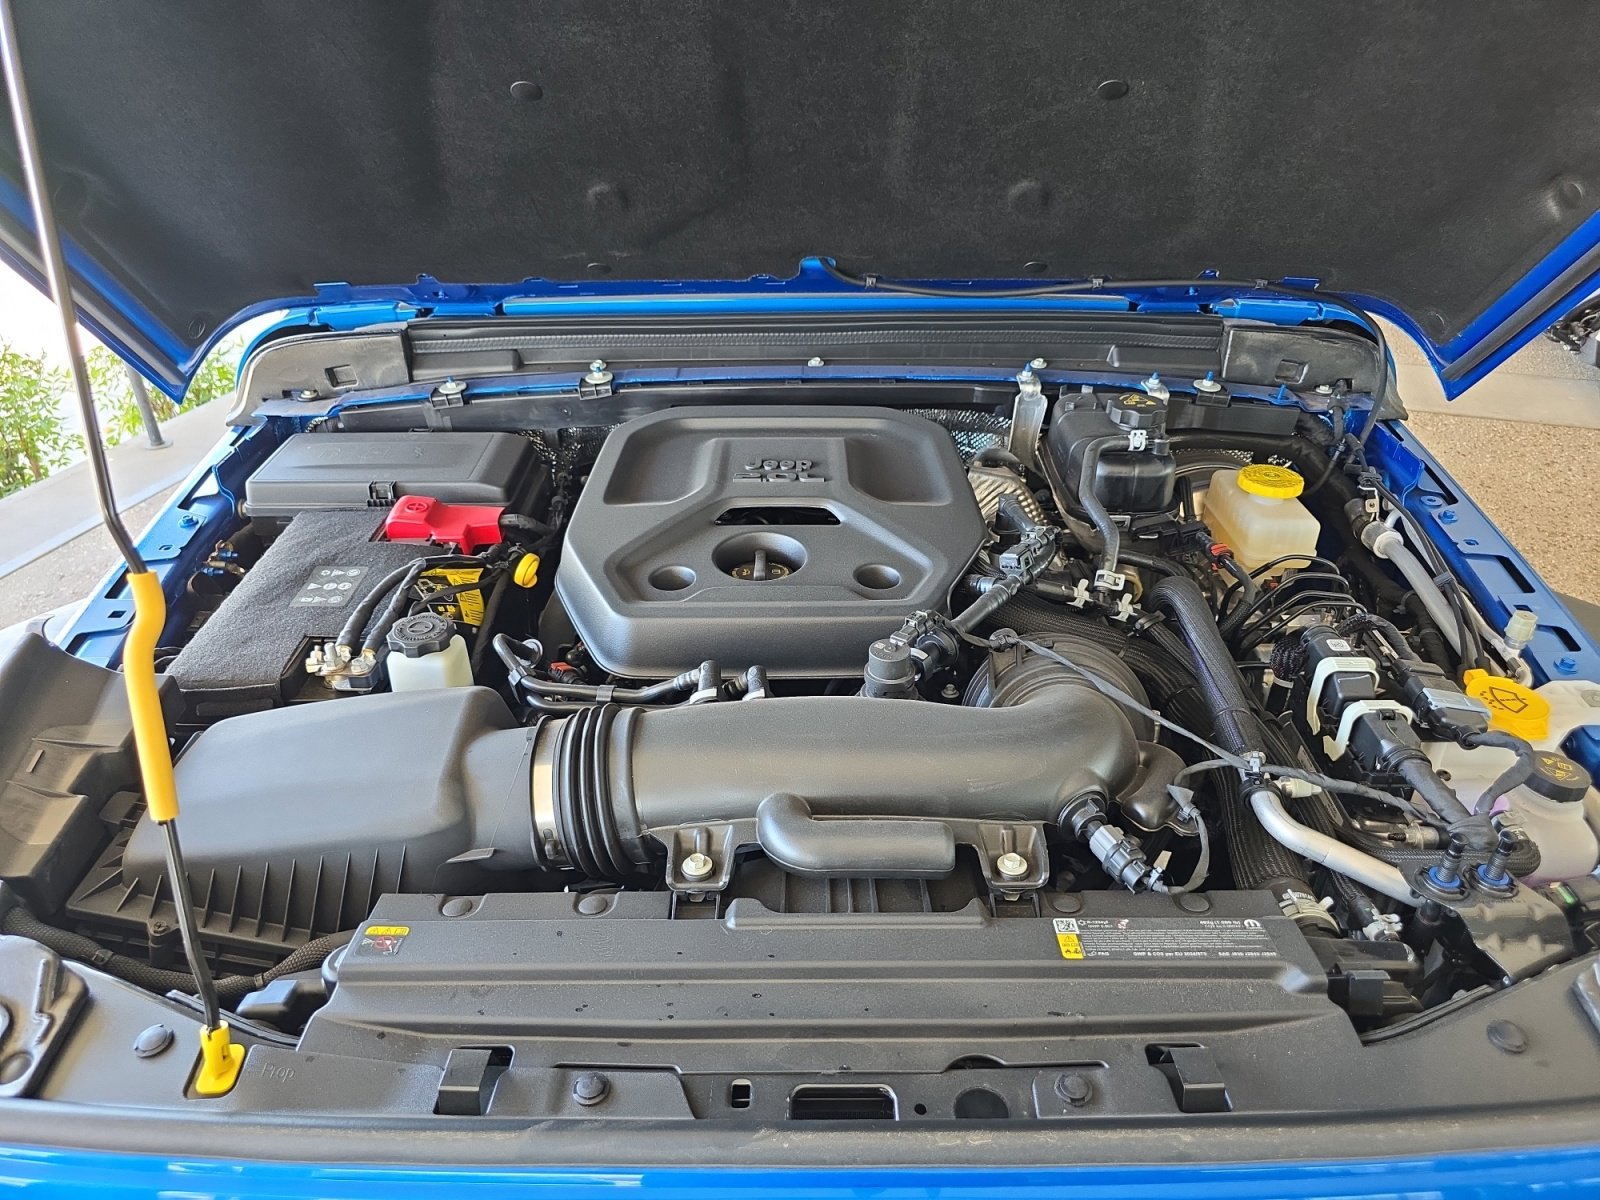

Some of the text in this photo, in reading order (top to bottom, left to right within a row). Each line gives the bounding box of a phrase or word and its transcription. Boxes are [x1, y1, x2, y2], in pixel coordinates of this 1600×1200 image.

[745, 460, 812, 472] Jeep
[733, 473, 824, 482] 2.0L
[262, 1062, 296, 1082] Prop
